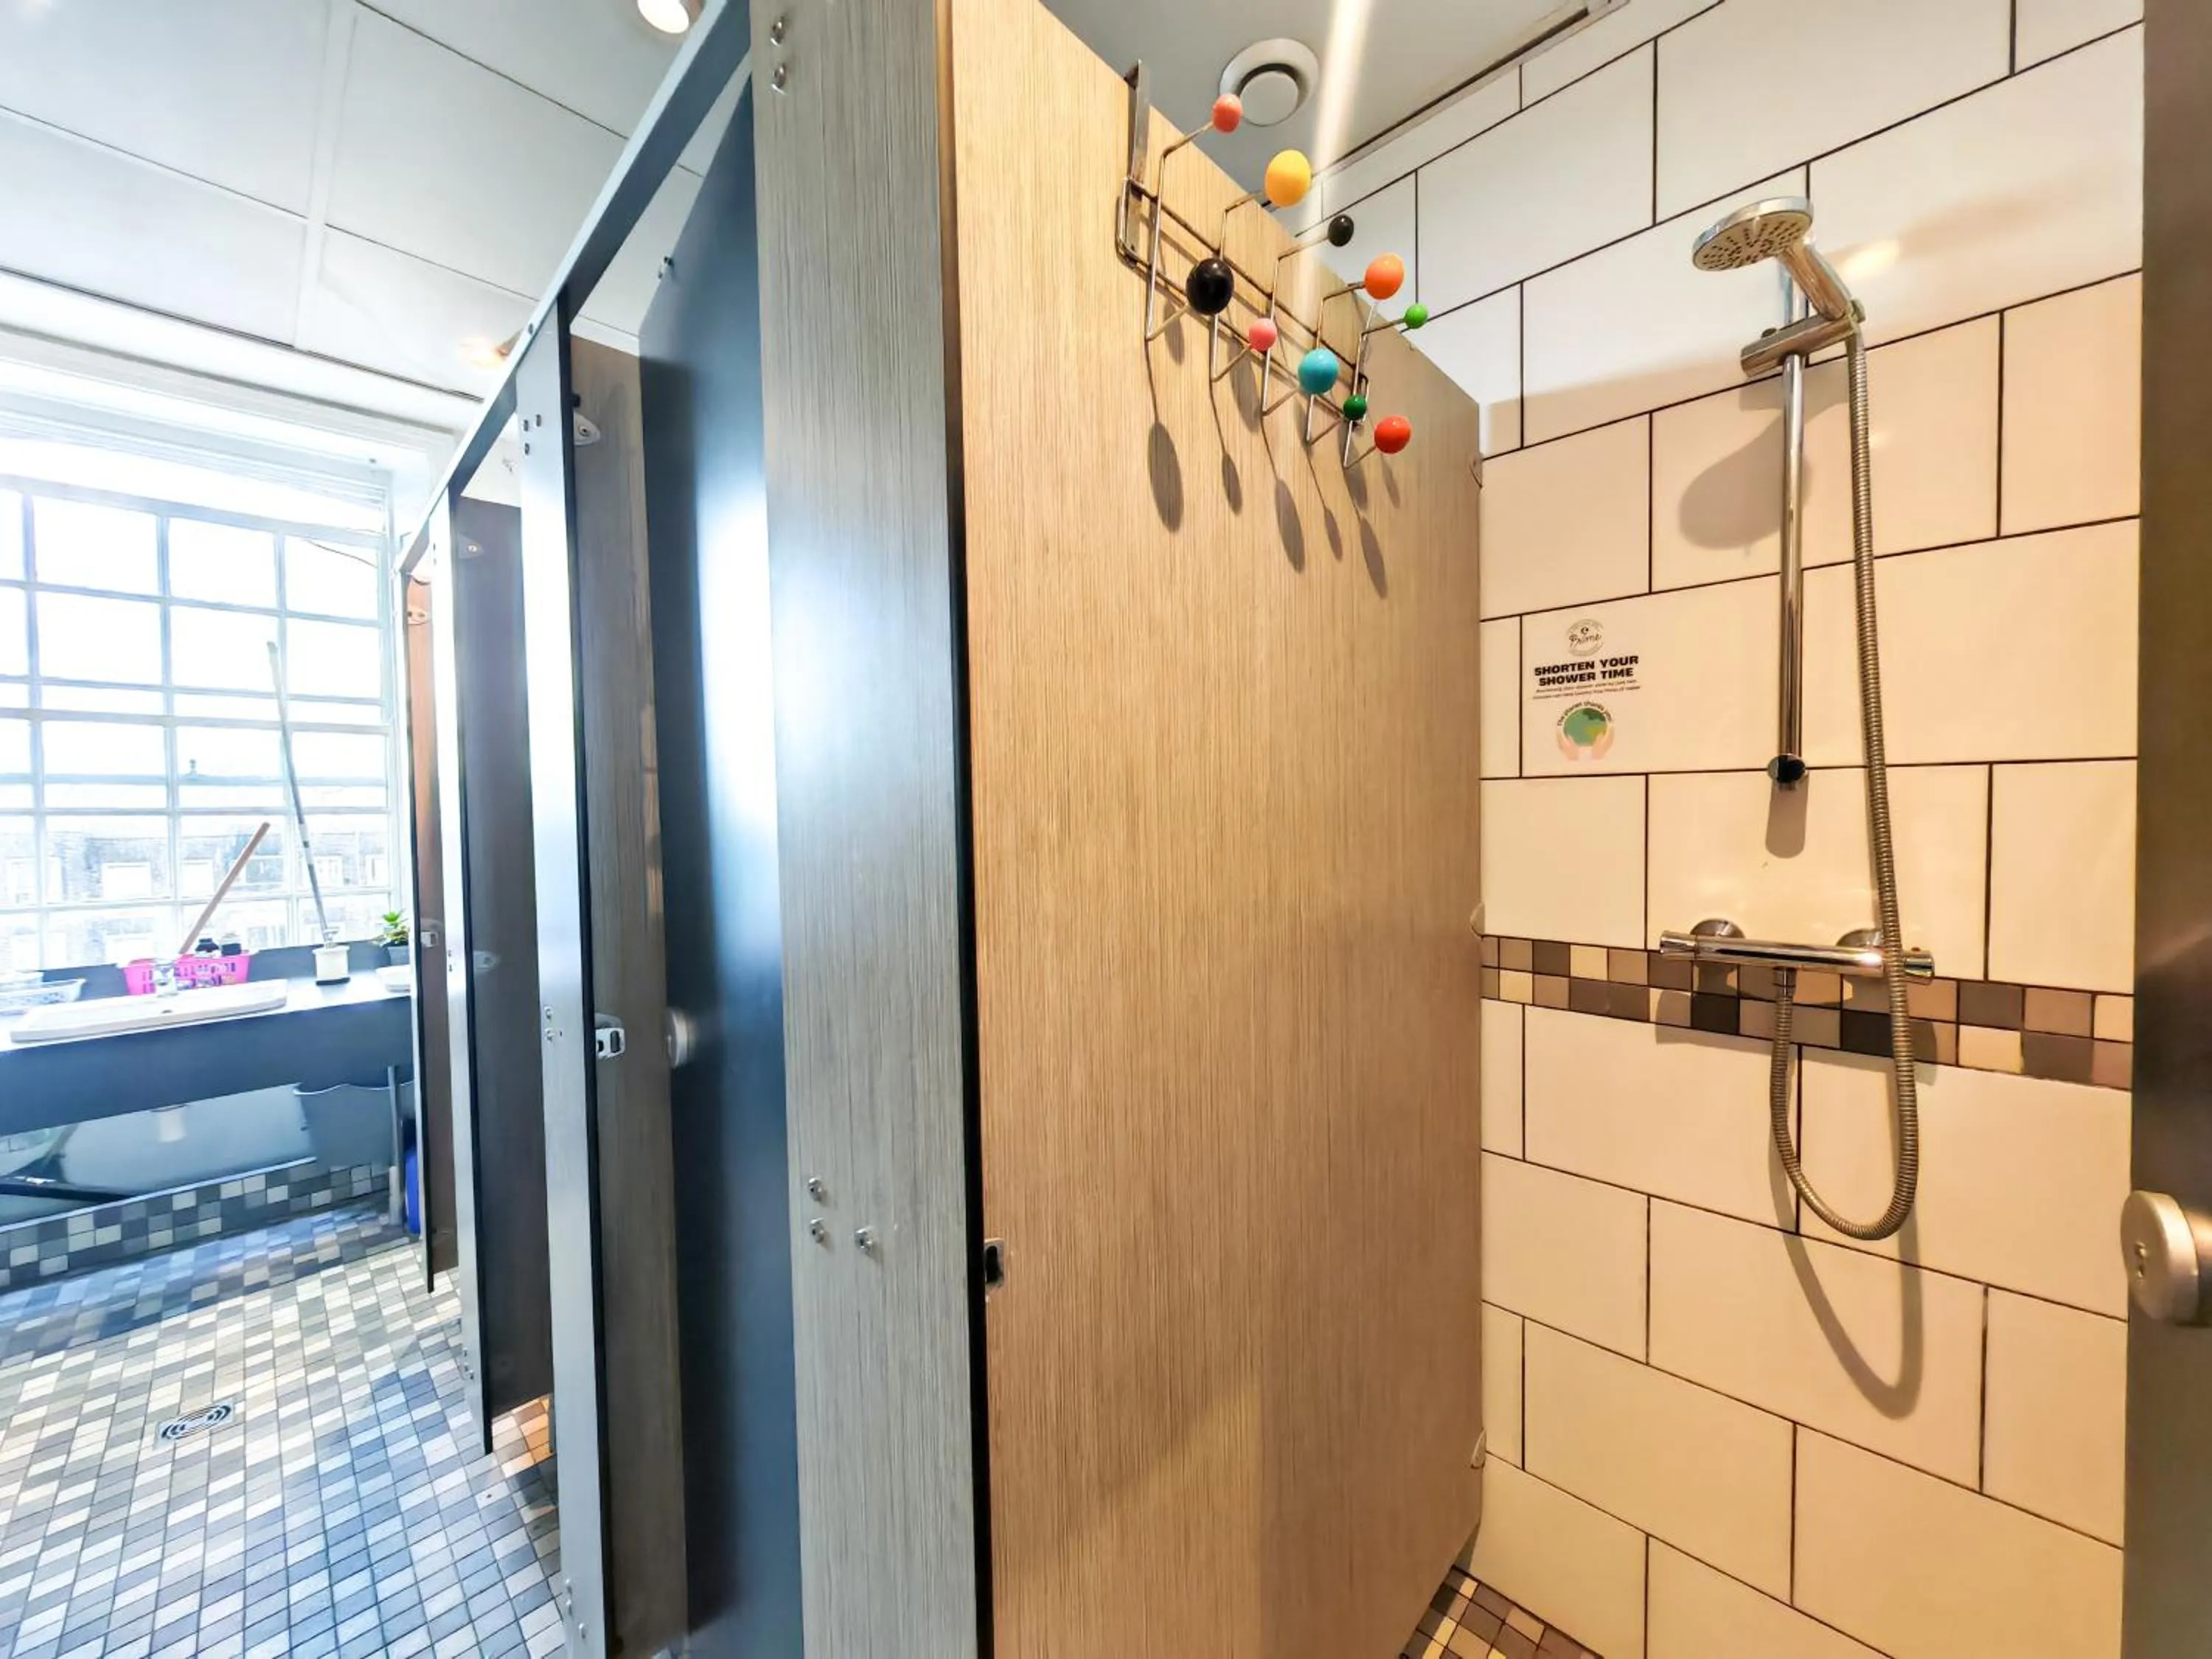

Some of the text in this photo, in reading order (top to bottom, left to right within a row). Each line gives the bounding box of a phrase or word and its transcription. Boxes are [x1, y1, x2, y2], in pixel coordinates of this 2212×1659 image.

[1534, 655, 1639, 676] SHORTEN YOUR
[1539, 672, 1596, 686] SHOWER
[1601, 668, 1635, 679] TIME
